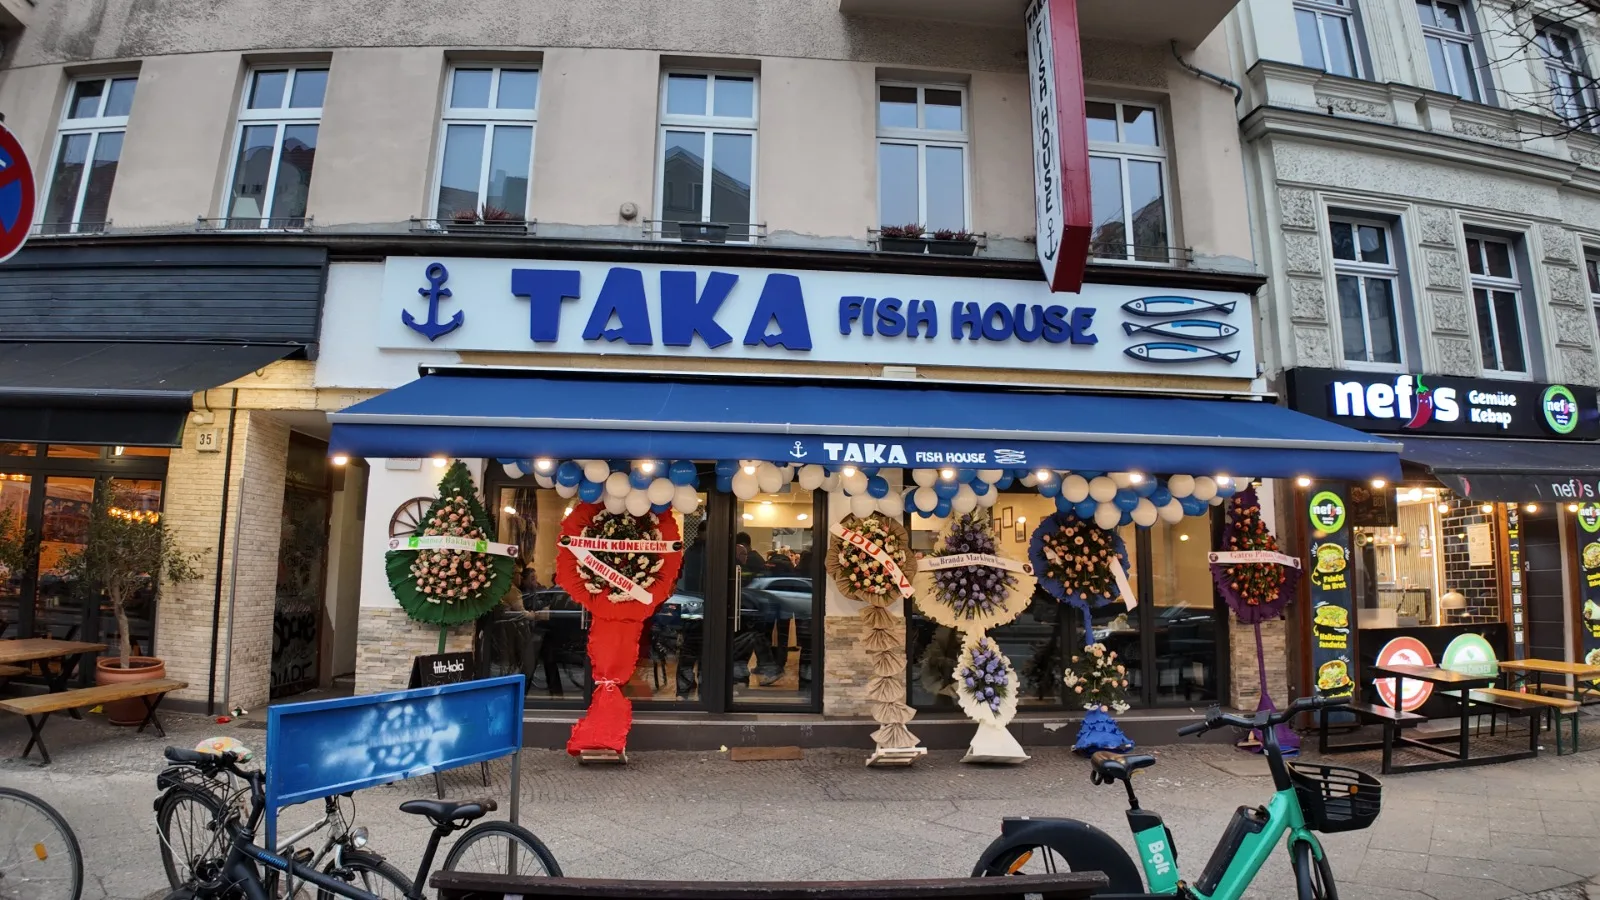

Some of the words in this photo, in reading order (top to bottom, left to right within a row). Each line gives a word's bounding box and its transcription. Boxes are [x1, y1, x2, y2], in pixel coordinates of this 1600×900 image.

[1036, 20, 1050, 103] FISH
[1041, 105, 1054, 214] HOUSE
[511, 267, 813, 351] TAKA
[839, 296, 938, 339] FISH
[951, 301, 1099, 345] HOUSE
[1468, 389, 1517, 407] Gemüse
[1470, 407, 1512, 428] Kebap
[199, 433, 212, 445] 35
[823, 442, 908, 464] TAKA
[915, 452, 943, 463] FISH
[946, 452, 987, 464] HOUSE
[841, 527, 881, 556] TDU
[608, 573, 634, 592] OLSUN
[433, 659, 465, 675] fritz-kola
[1148, 840, 1170, 875] Bolt
